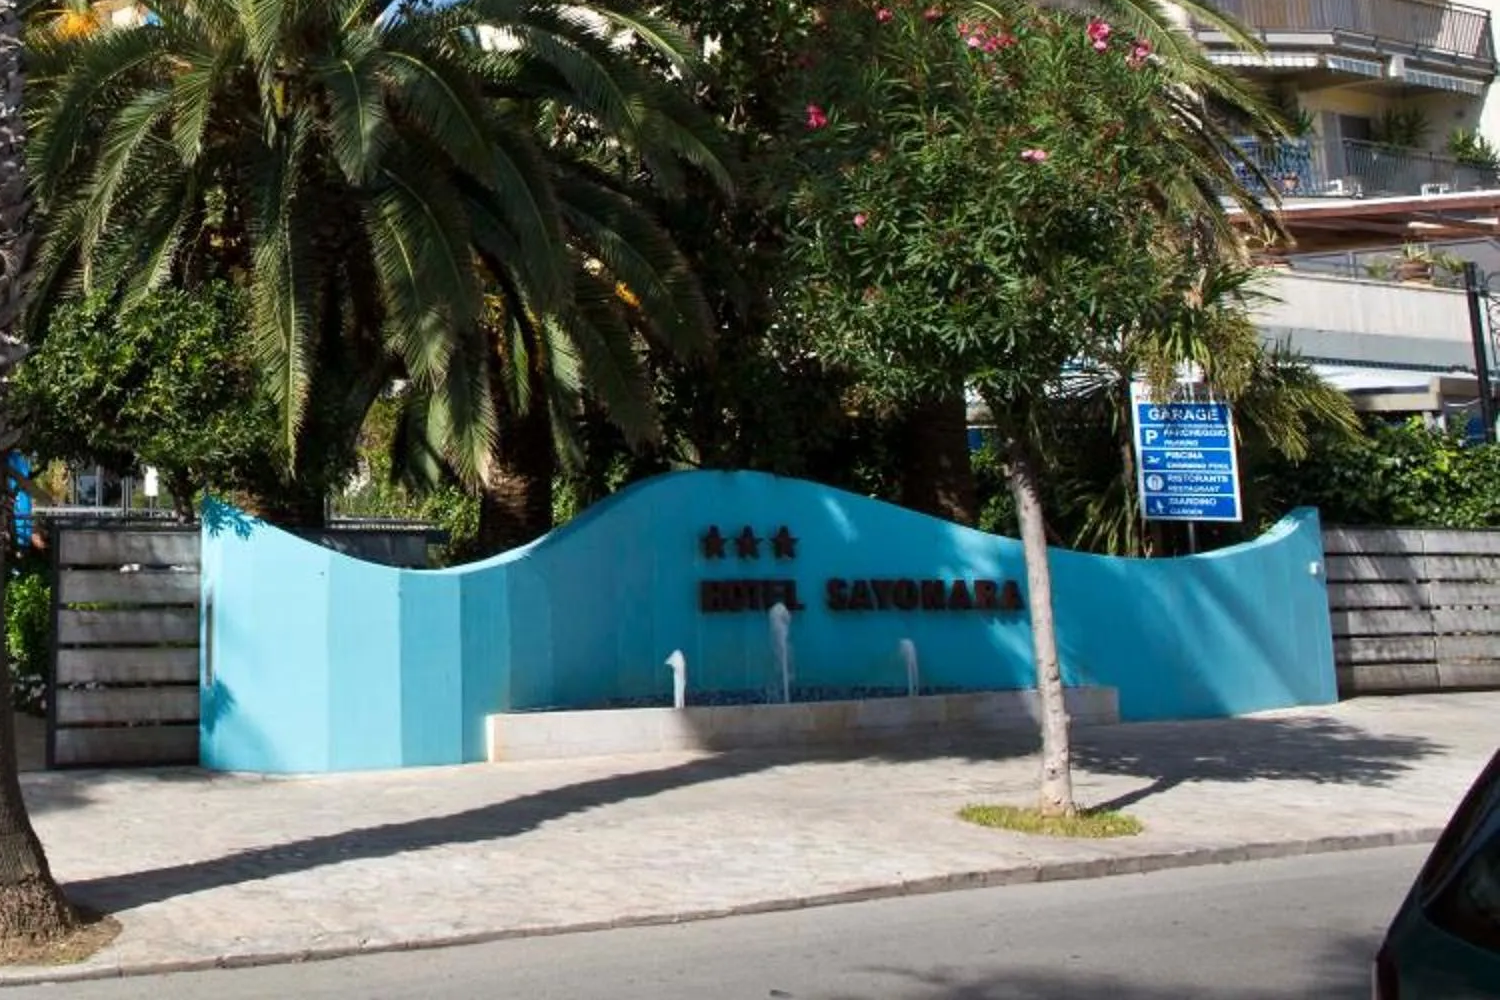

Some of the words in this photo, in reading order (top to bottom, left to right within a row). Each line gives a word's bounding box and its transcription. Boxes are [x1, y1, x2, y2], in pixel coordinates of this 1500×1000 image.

[1147, 407, 1219, 421] GARAGE
[1145, 429, 1158, 445] P
[701, 580, 804, 611] HOTEL
[827, 578, 1025, 611] SAYONARA
